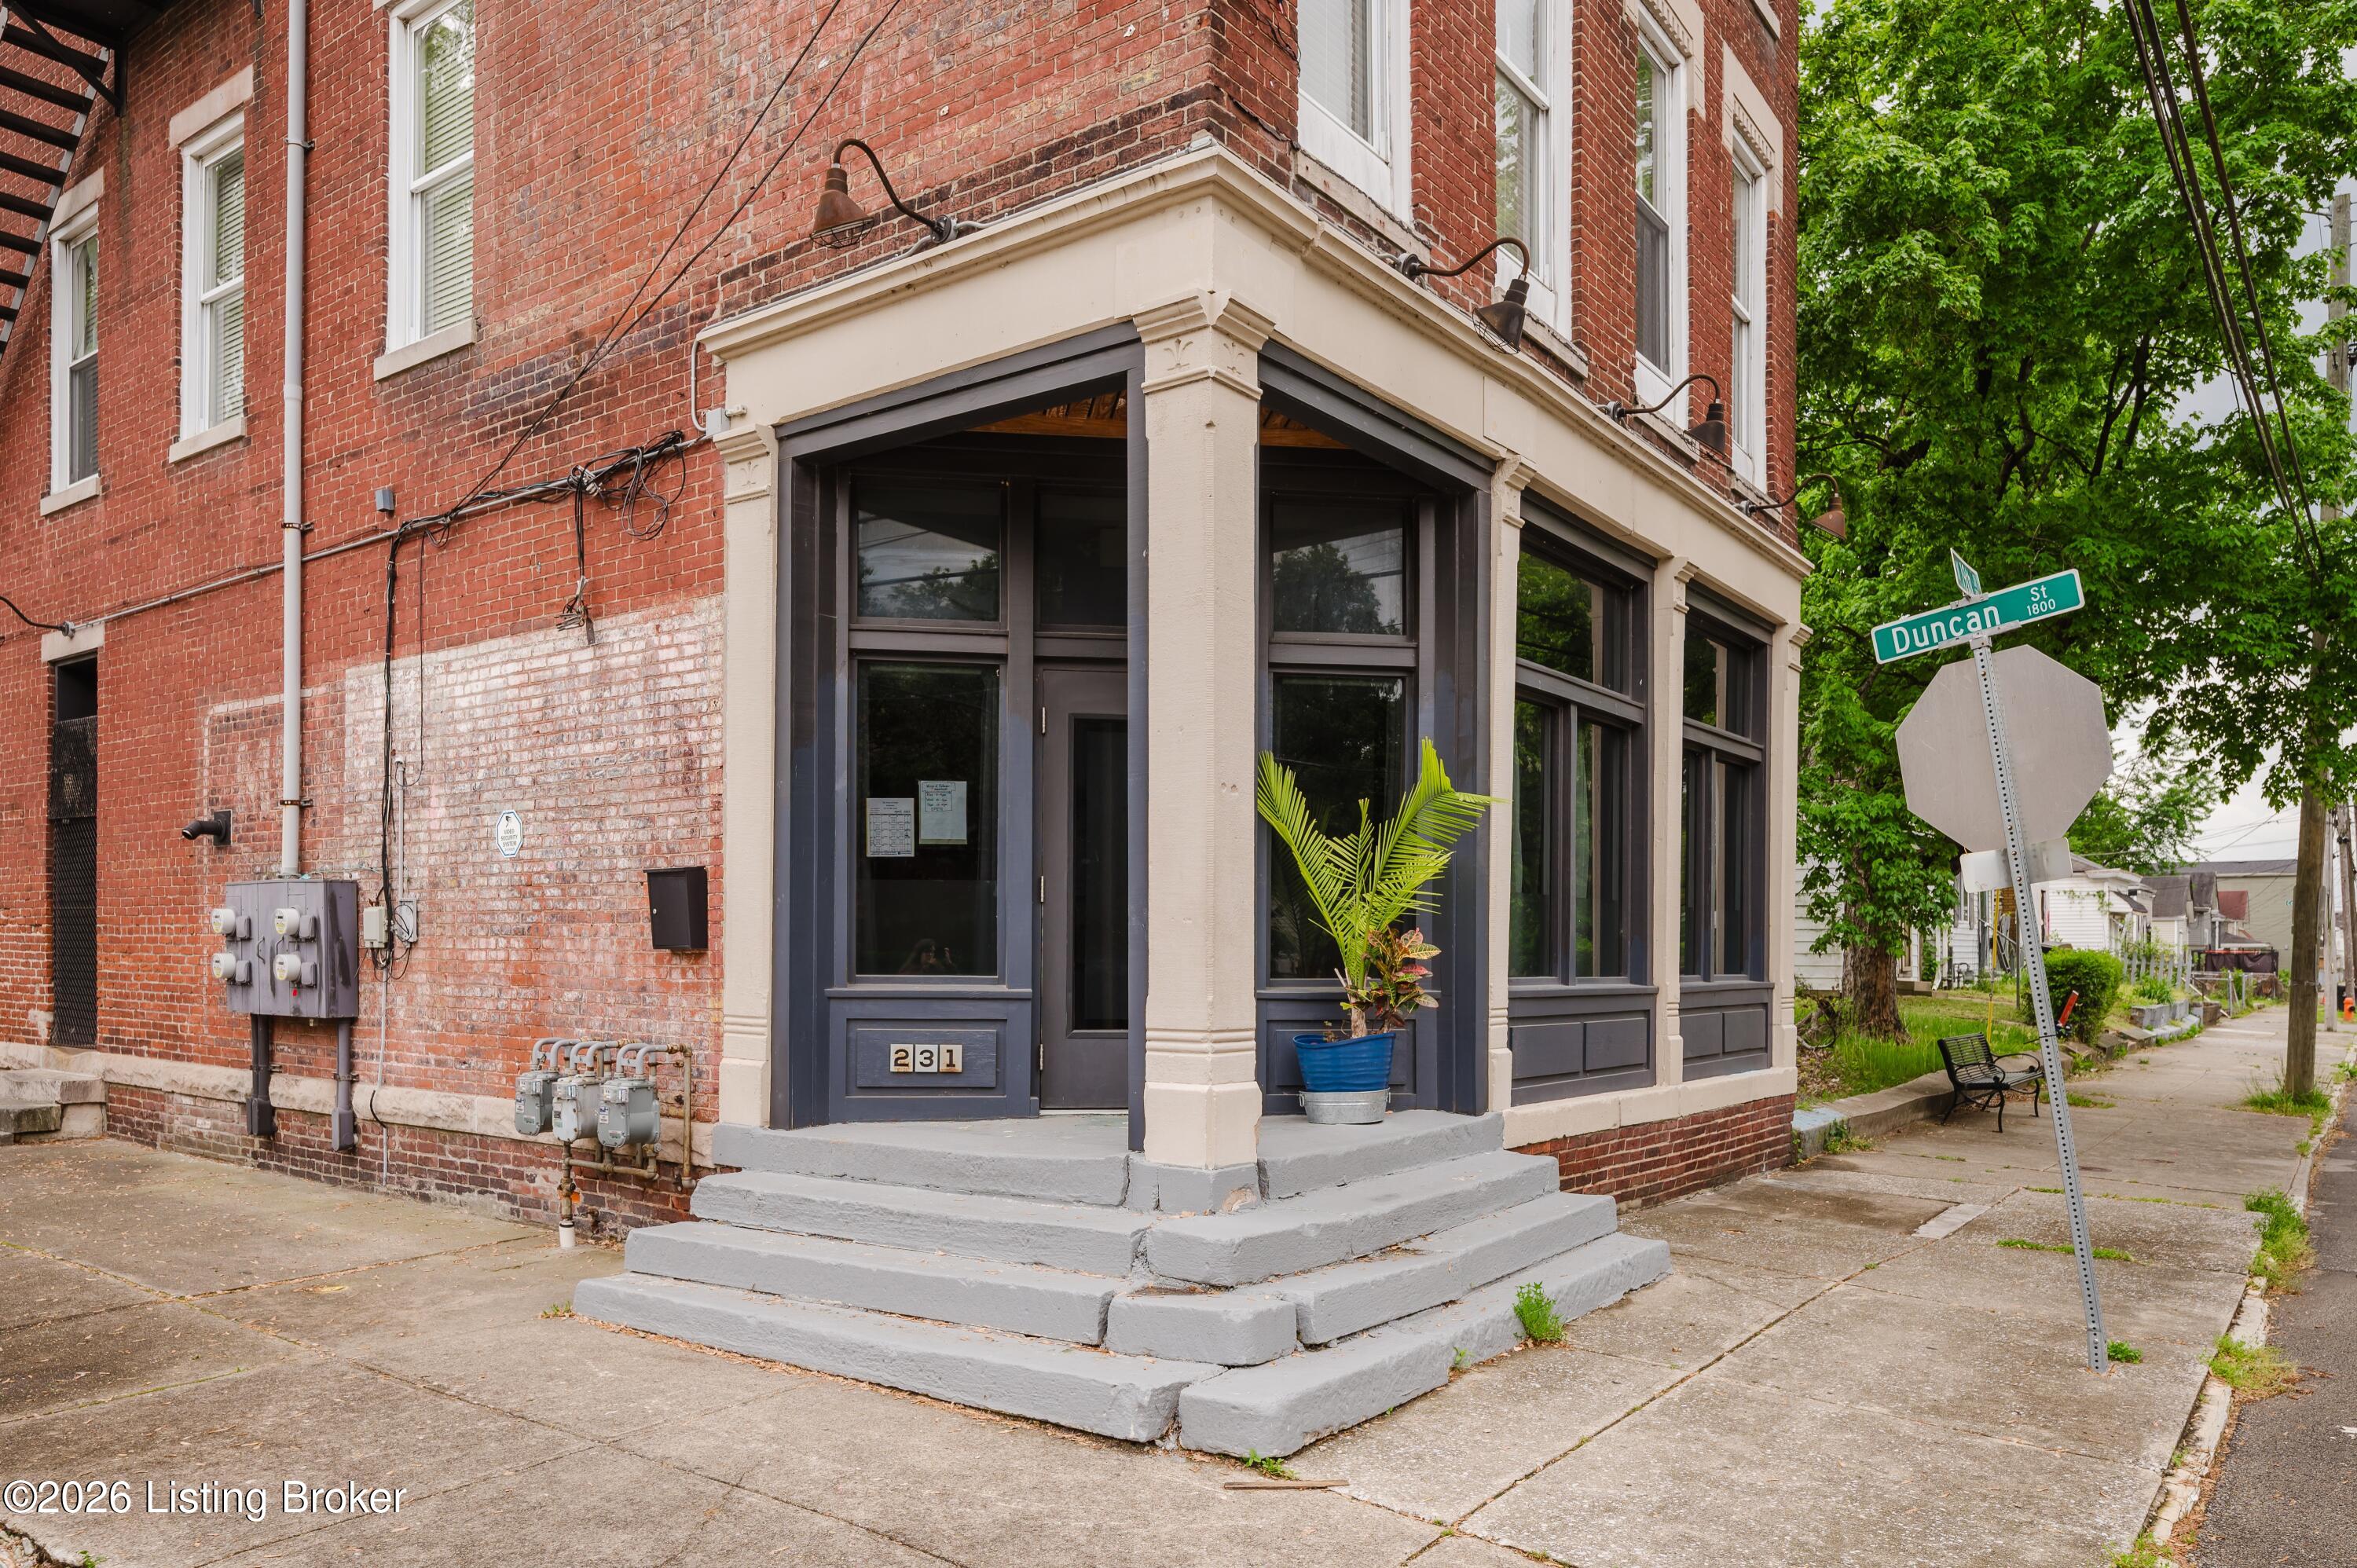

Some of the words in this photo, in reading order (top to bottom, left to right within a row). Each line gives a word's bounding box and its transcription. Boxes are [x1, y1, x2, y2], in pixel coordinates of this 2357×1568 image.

[2026, 599, 2056, 617] 1800
[1892, 606, 2001, 654] Duncan
[2030, 584, 2048, 603] St
[893, 1049, 956, 1068] 231
